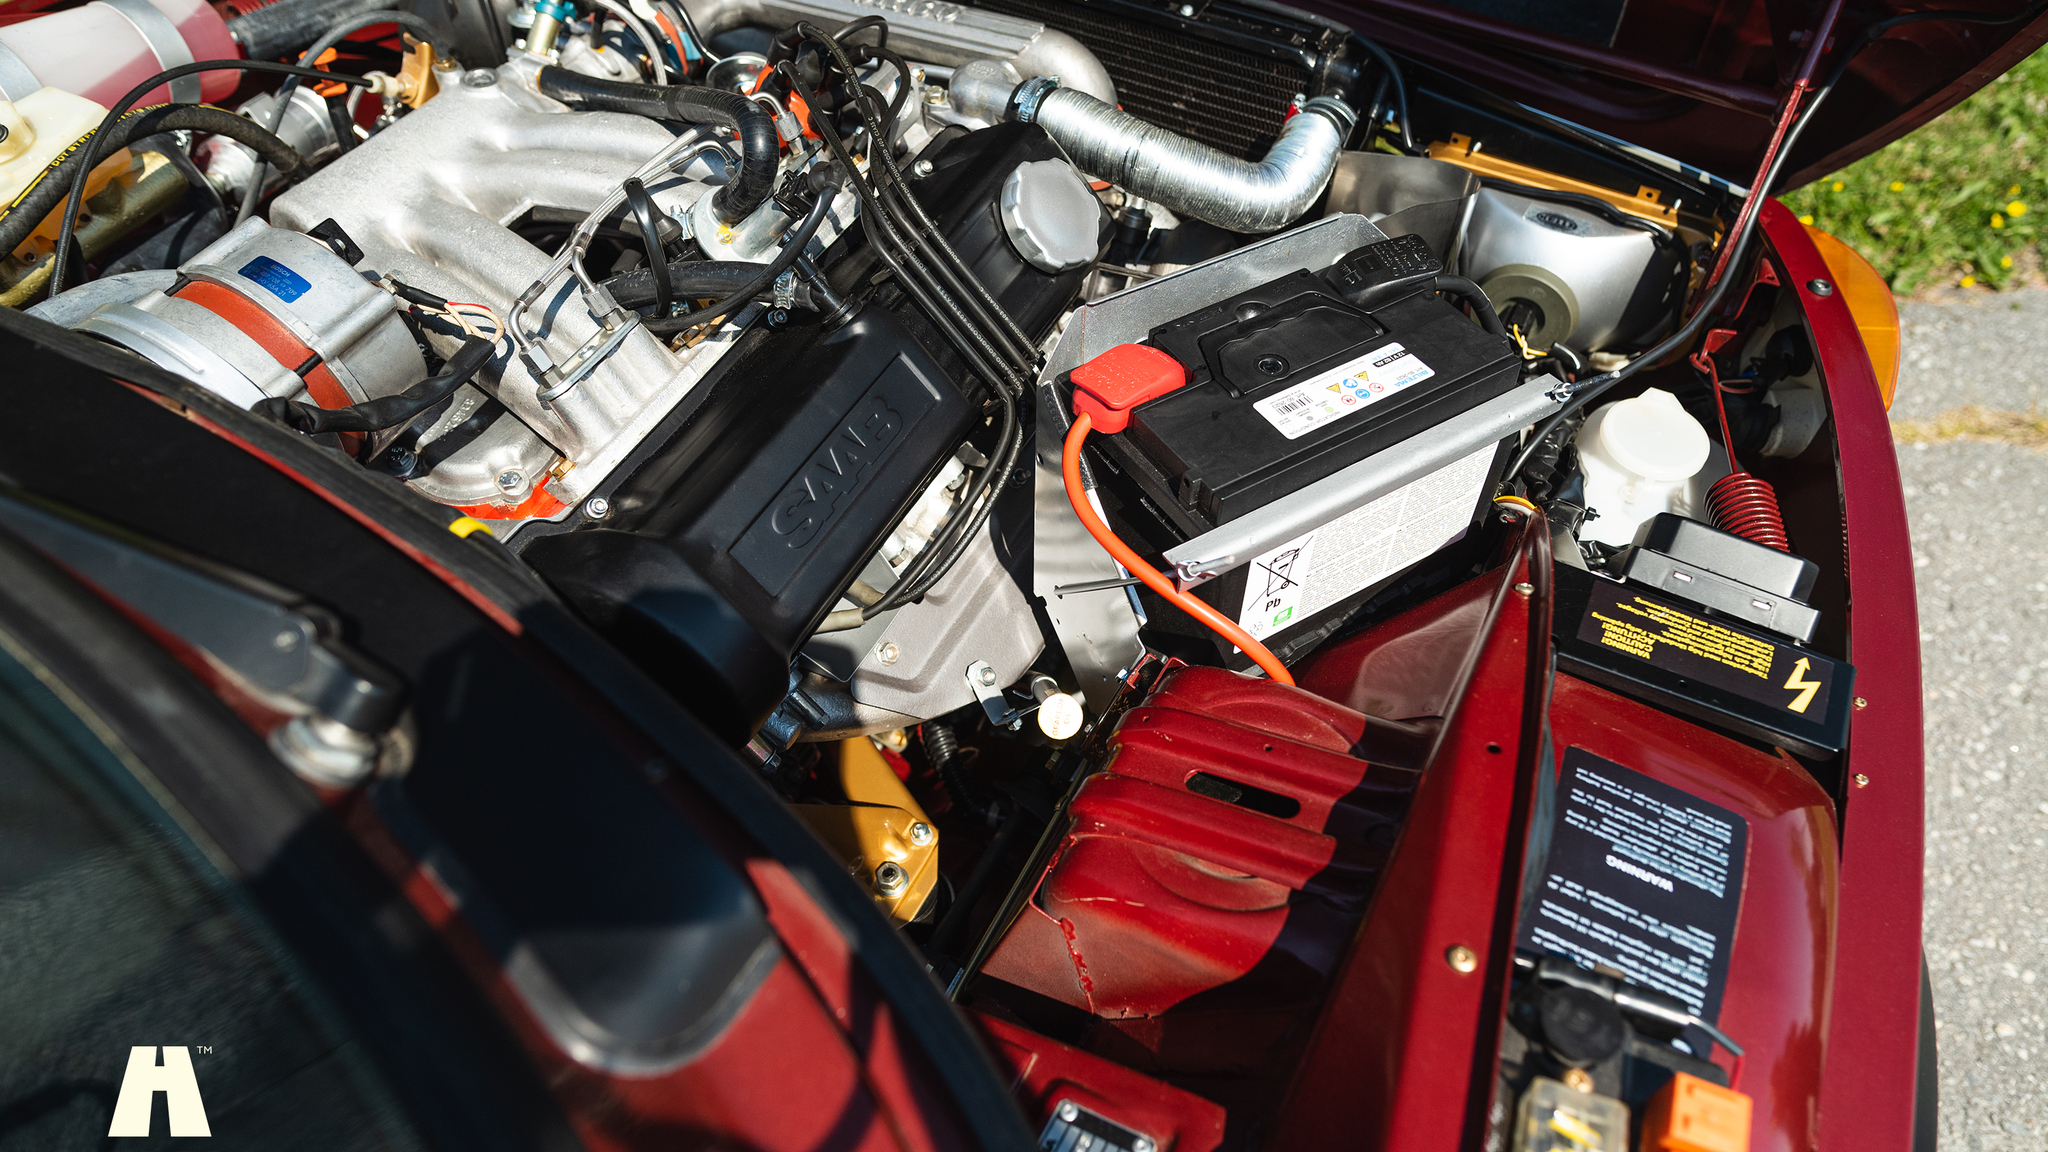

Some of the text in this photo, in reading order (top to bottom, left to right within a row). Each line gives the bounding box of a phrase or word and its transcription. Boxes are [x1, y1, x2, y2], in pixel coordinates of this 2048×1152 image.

[869, 120, 880, 137] CLASS
[881, 147, 902, 182] BOUGICORD
[933, 230, 960, 264] BOUGICORD
[270, 263, 290, 277] BOSCH
[939, 289, 958, 310] CLASS
[984, 291, 1000, 309] CLASS
[956, 309, 968, 322] 403
[965, 321, 998, 357] BOUGICORD
[995, 355, 1024, 391] AUTORADIO
[1393, 369, 1429, 387] BILTEMA
[772, 394, 903, 549] SAAB
[1265, 597, 1281, 612] Pb
[1600, 622, 1656, 646] ACHTUNG!
[1602, 630, 1654, 653] CAUTION!
[1599, 636, 1652, 660] VARNING!
[1603, 853, 1674, 893] WARNING
